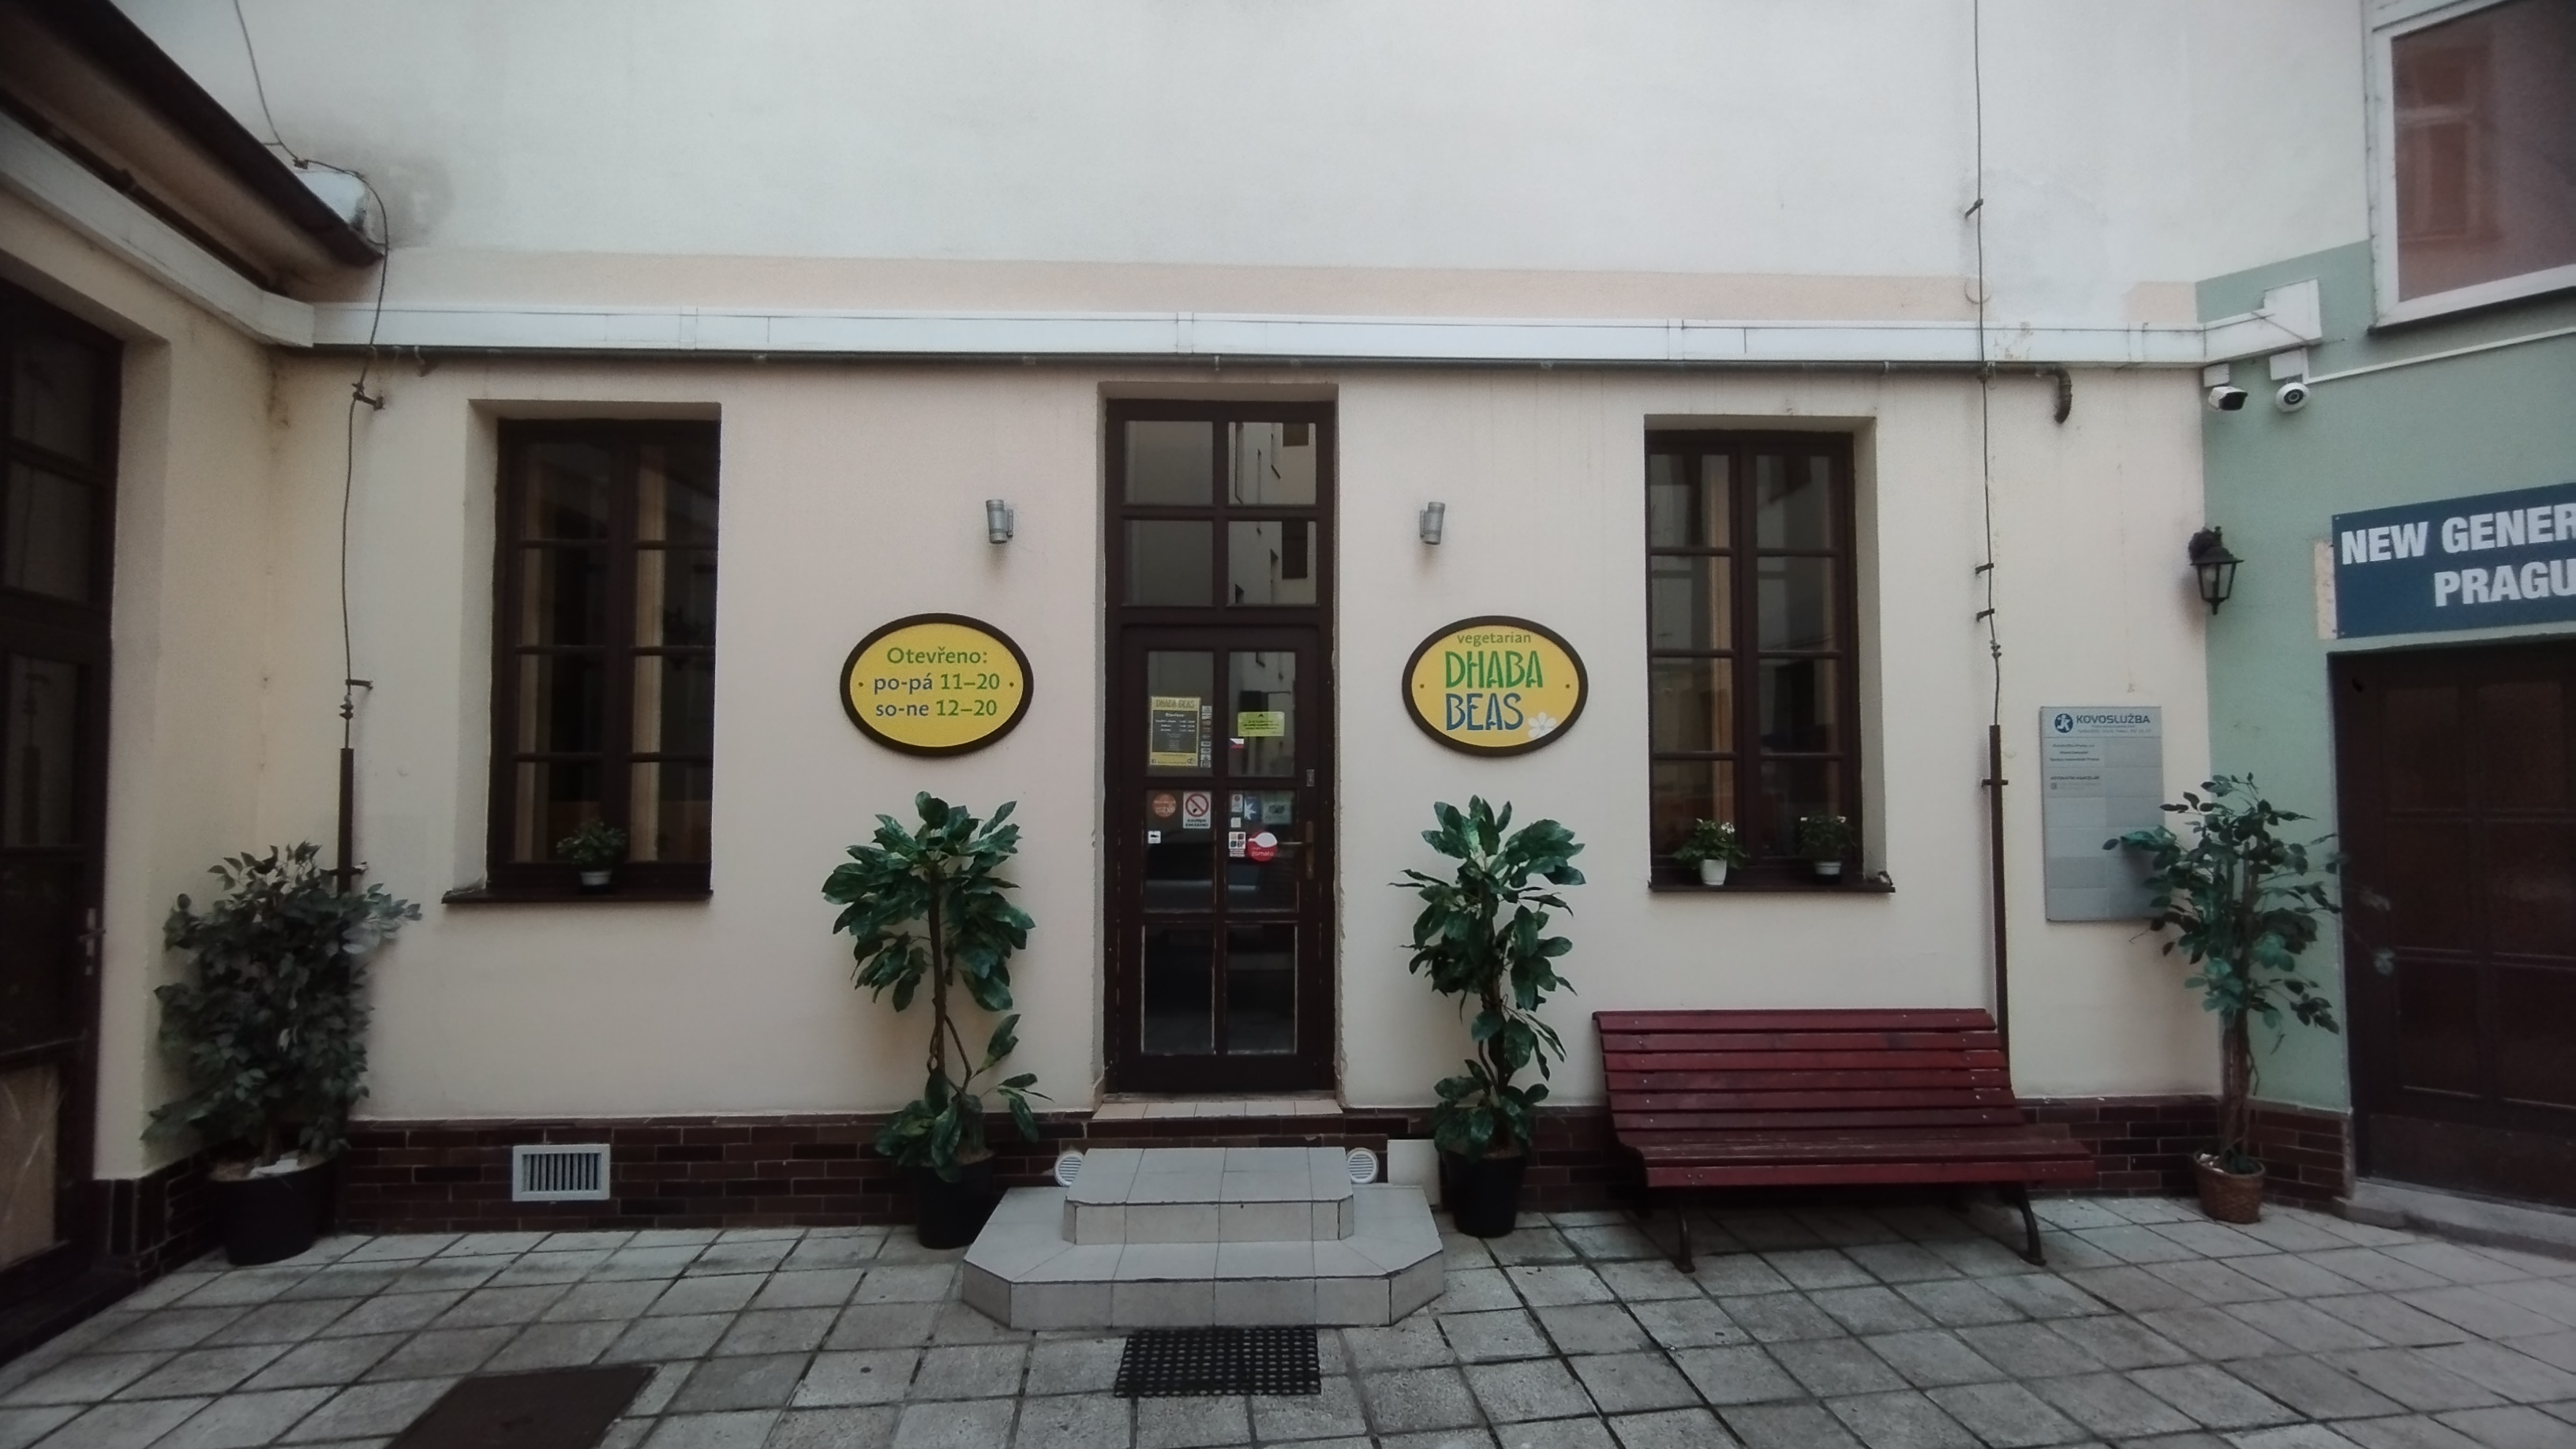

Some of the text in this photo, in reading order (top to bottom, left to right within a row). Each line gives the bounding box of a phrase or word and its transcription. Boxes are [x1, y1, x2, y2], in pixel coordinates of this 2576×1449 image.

[2341, 521, 2428, 565] NEW
[2434, 558, 2576, 607] PRAGU
[1457, 631, 1532, 647] vegetarian
[886, 646, 987, 664] Otevřeno:
[1445, 650, 1544, 689] DHABA
[874, 672, 933, 695] po-pá
[875, 702, 930, 717] so-ne
[1446, 693, 1524, 732] BEAS
[2076, 713, 2151, 724] KOVOSLUŽBA
